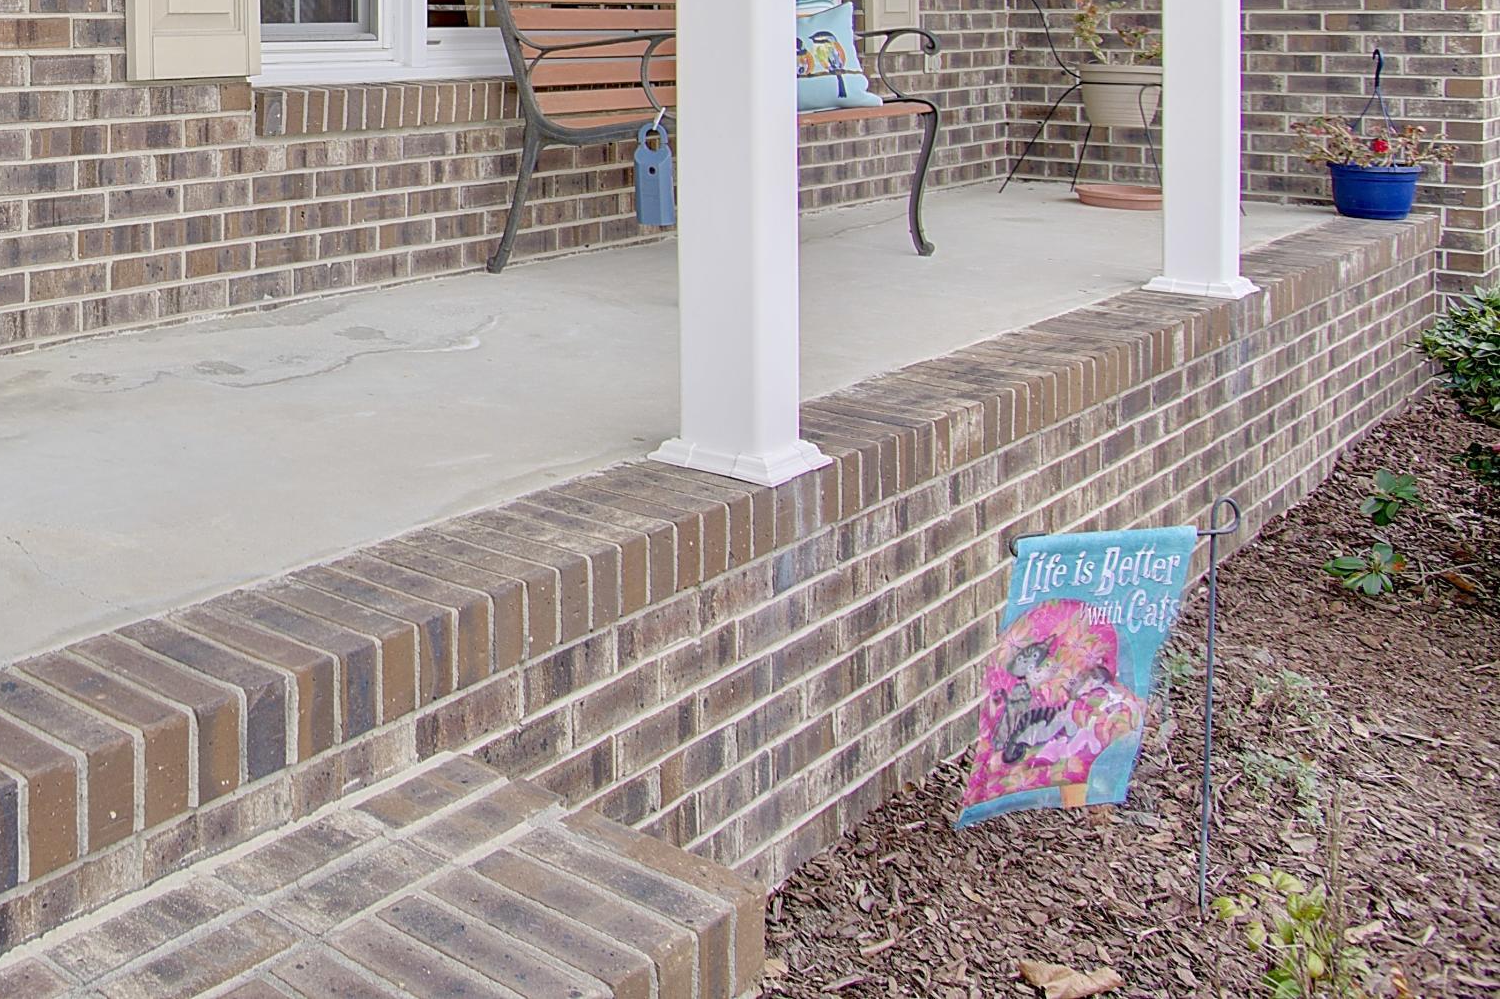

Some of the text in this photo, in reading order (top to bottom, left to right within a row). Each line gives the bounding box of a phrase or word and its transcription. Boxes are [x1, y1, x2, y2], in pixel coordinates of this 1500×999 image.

[1017, 543, 1181, 606] Life is Better
[1080, 588, 1181, 634] with Cats
